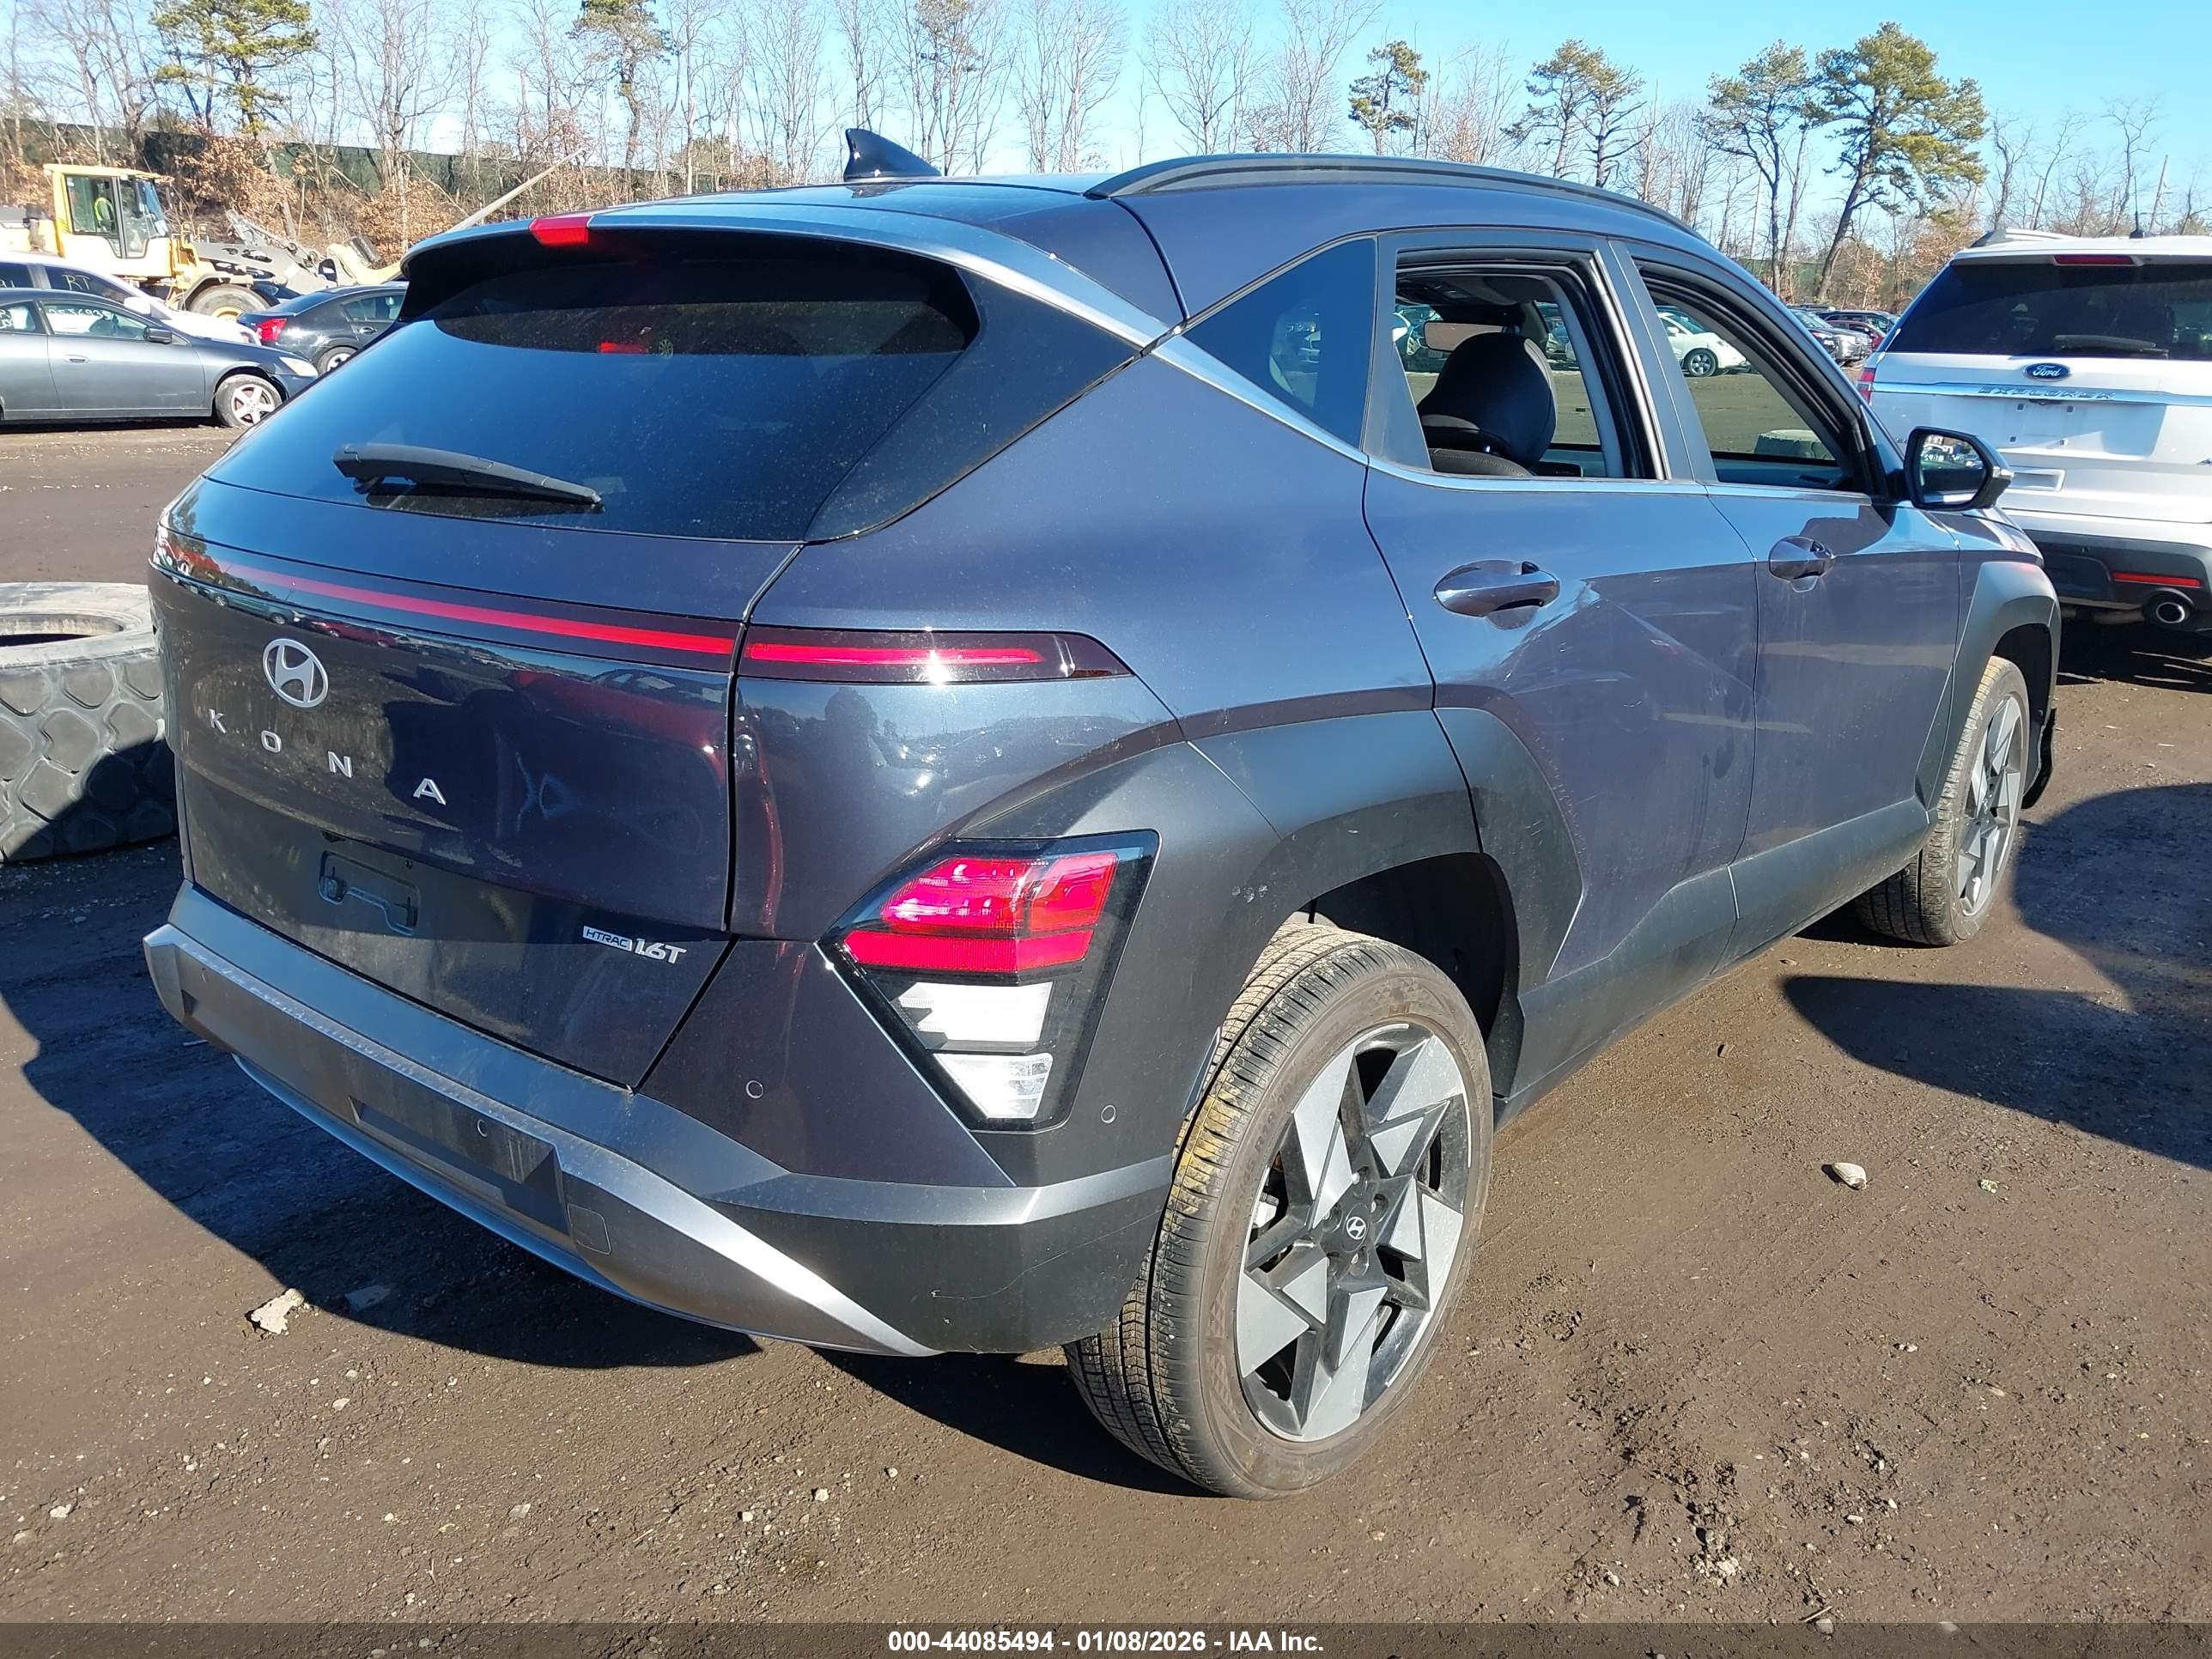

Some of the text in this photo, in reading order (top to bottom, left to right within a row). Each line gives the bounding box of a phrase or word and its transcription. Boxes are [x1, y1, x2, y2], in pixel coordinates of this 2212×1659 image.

[62, 274, 90, 290] RT
[2033, 365, 2061, 377] Ford
[1978, 386, 2116, 399] EXPLORER
[208, 708, 447, 805] KONA
[585, 928, 629, 948] HTRAC
